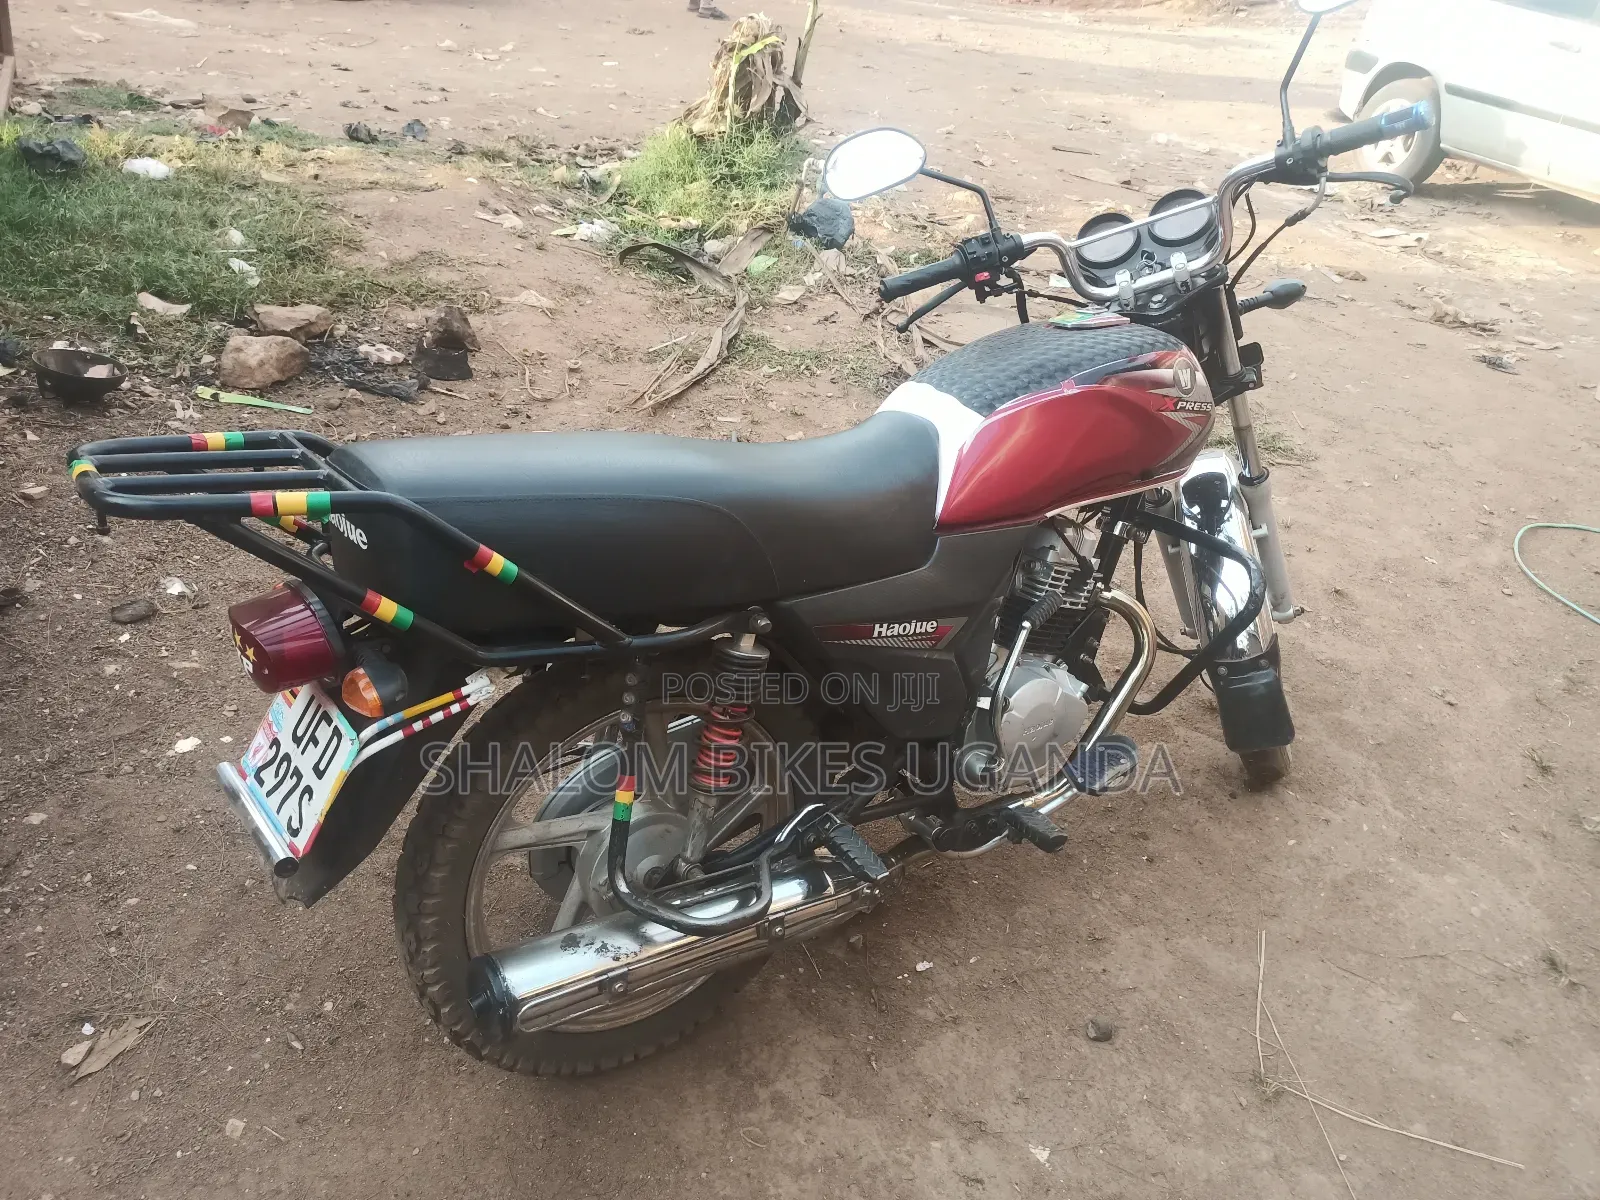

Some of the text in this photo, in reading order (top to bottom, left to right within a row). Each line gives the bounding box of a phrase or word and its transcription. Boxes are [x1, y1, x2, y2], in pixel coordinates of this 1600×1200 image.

[1159, 396, 1213, 412] XPRESS
[328, 513, 368, 550] aojue
[872, 619, 938, 638] Haojue
[291, 694, 344, 781] UFD
[253, 737, 314, 838] 297S
